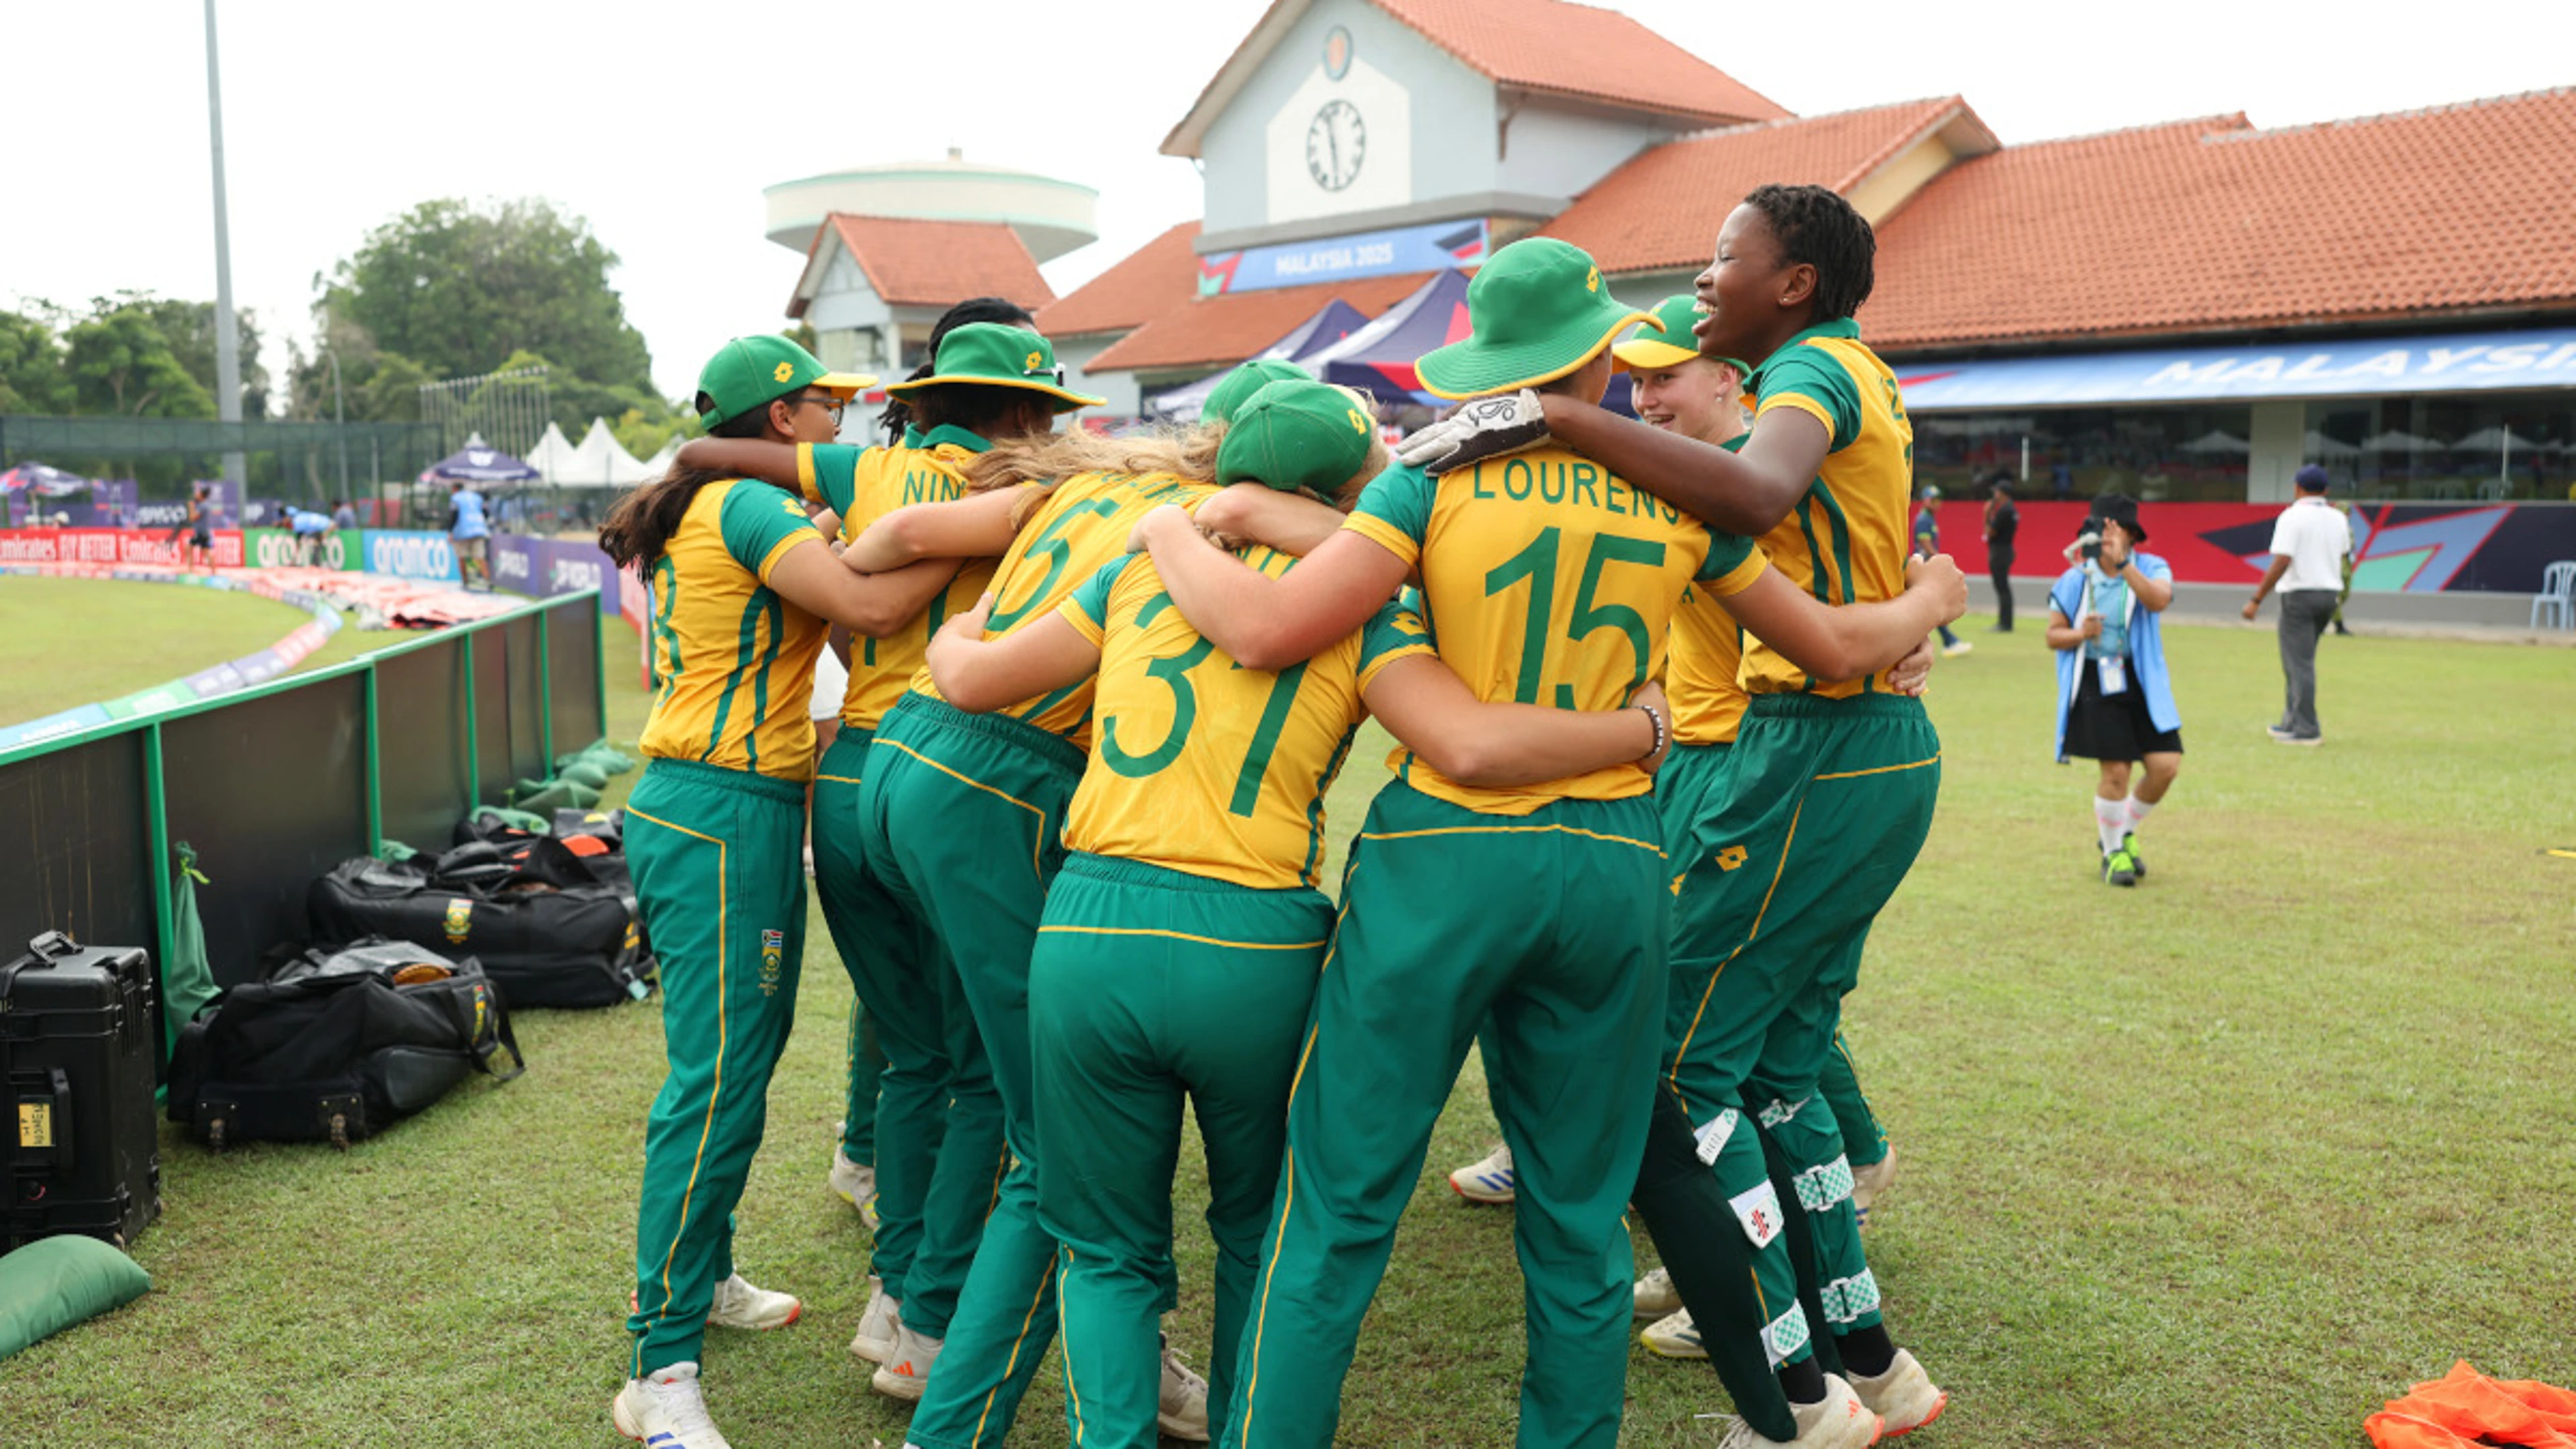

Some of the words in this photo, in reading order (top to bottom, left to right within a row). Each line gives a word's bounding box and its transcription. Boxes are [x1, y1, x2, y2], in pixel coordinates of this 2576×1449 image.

[1277, 246, 1353, 276] MALAYSIA
[1356, 241, 1393, 266] 2025
[2143, 341, 2576, 386] MALAYSI
[374, 536, 450, 578] aramco
[985, 497, 1121, 632] 5
[1485, 526, 1666, 711] 15
[1101, 590, 1308, 818] 37
